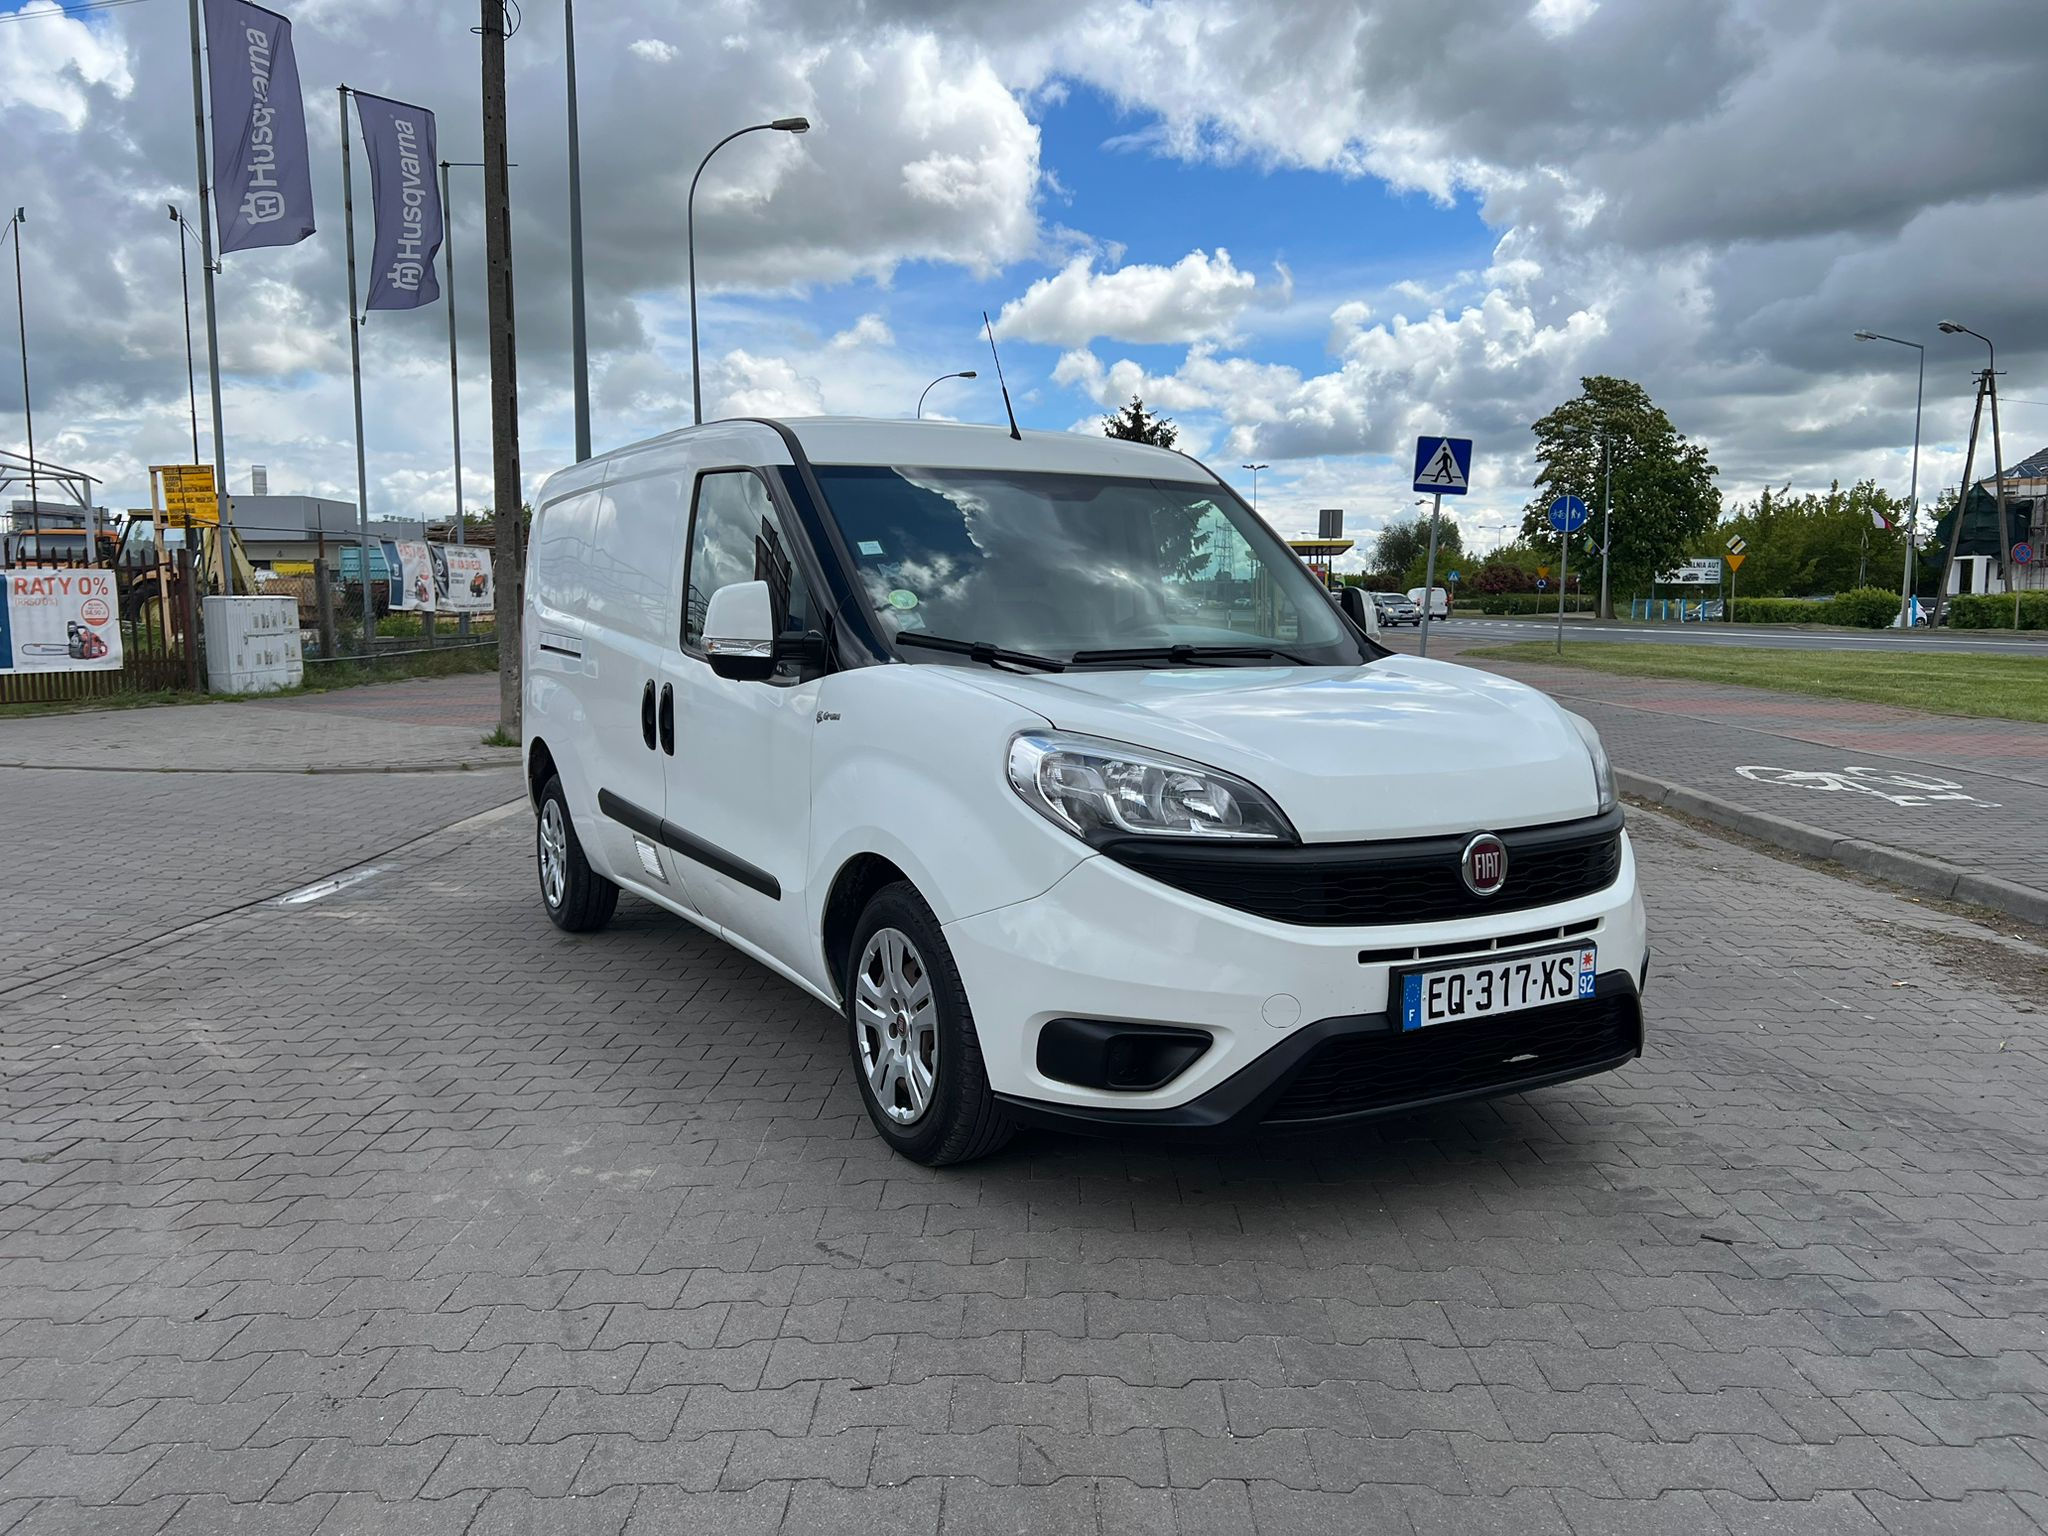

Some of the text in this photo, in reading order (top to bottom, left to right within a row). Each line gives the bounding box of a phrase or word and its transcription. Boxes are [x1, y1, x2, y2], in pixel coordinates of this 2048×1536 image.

[394, 119, 426, 260] Husqvarna
[14, 576, 109, 596] RATY 0%
[1474, 851, 1500, 880] FIAT
[1408, 1008, 1416, 1022] F
[1578, 974, 1595, 995] 92
